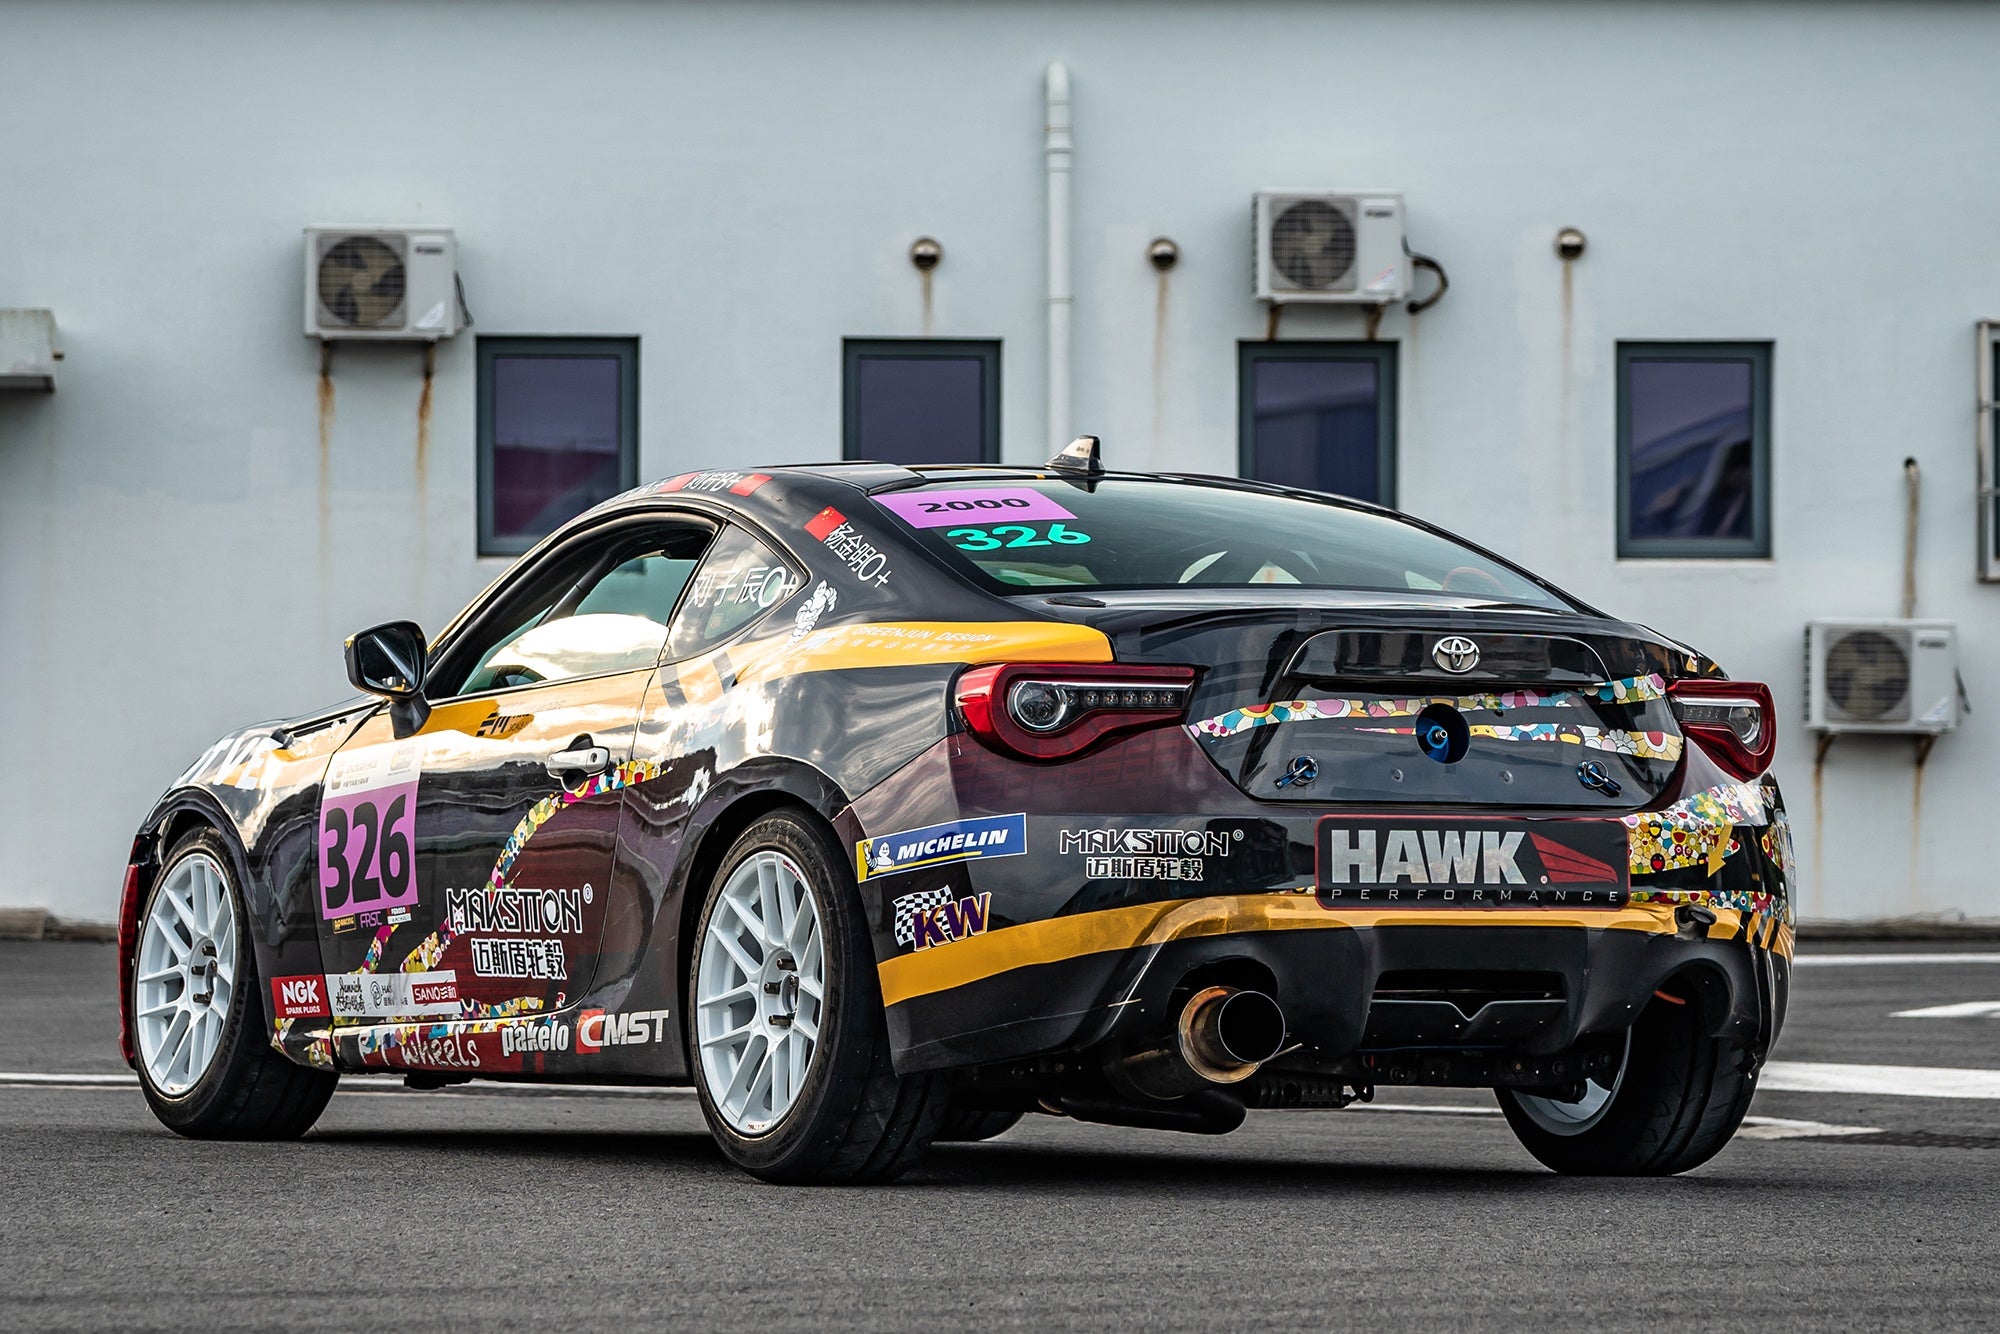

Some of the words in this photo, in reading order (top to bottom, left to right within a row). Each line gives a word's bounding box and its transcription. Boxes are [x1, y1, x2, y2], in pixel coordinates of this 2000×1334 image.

[917, 498, 1031, 513] 2000
[946, 523, 1092, 551] 326
[935, 631, 999, 643] DESIGN
[325, 793, 409, 910] 326
[897, 828, 1009, 861] MICHELIN
[1330, 829, 1528, 884] HAWK
[1085, 856, 1204, 881] 迈斯盾轮毂
[1330, 888, 1619, 902] PERFORMANCE
[912, 891, 992, 952] KW
[471, 938, 568, 981] 迈斯盾轮毂
[281, 980, 320, 1005] NGK
[285, 1006, 303, 1015] SPARK
[303, 1005, 321, 1014] PLUGS
[500, 1018, 570, 1057] pakelo
[580, 1009, 670, 1047] CMST
